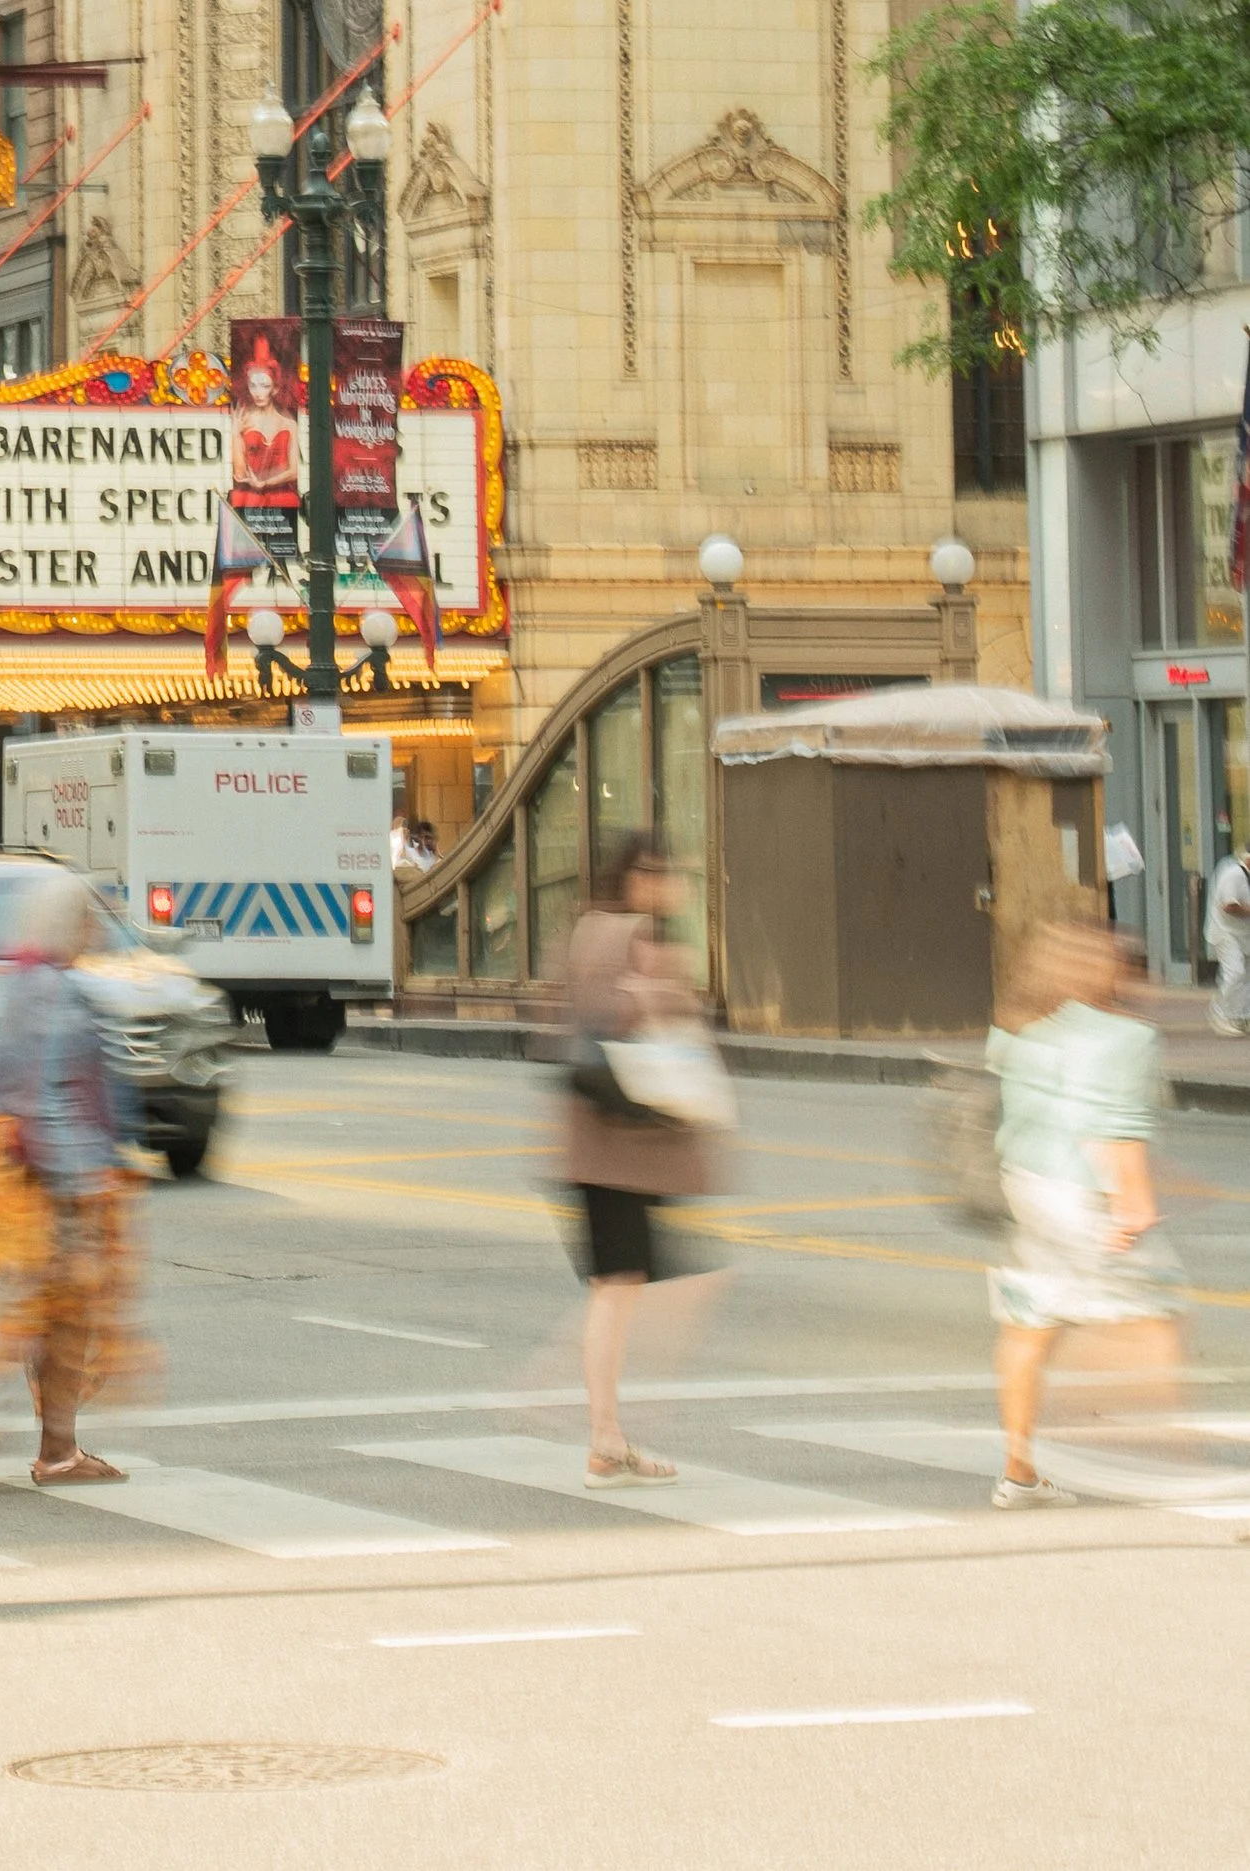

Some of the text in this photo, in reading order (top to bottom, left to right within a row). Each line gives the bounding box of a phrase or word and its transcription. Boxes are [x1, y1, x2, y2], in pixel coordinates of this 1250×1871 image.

[99, 487, 213, 525] SPECI
[131, 549, 210, 588] AND
[52, 781, 89, 804] CHICAGO
[215, 772, 308, 795] POLICE
[55, 807, 86, 829] POLICE
[337, 853, 382, 871] 6129
